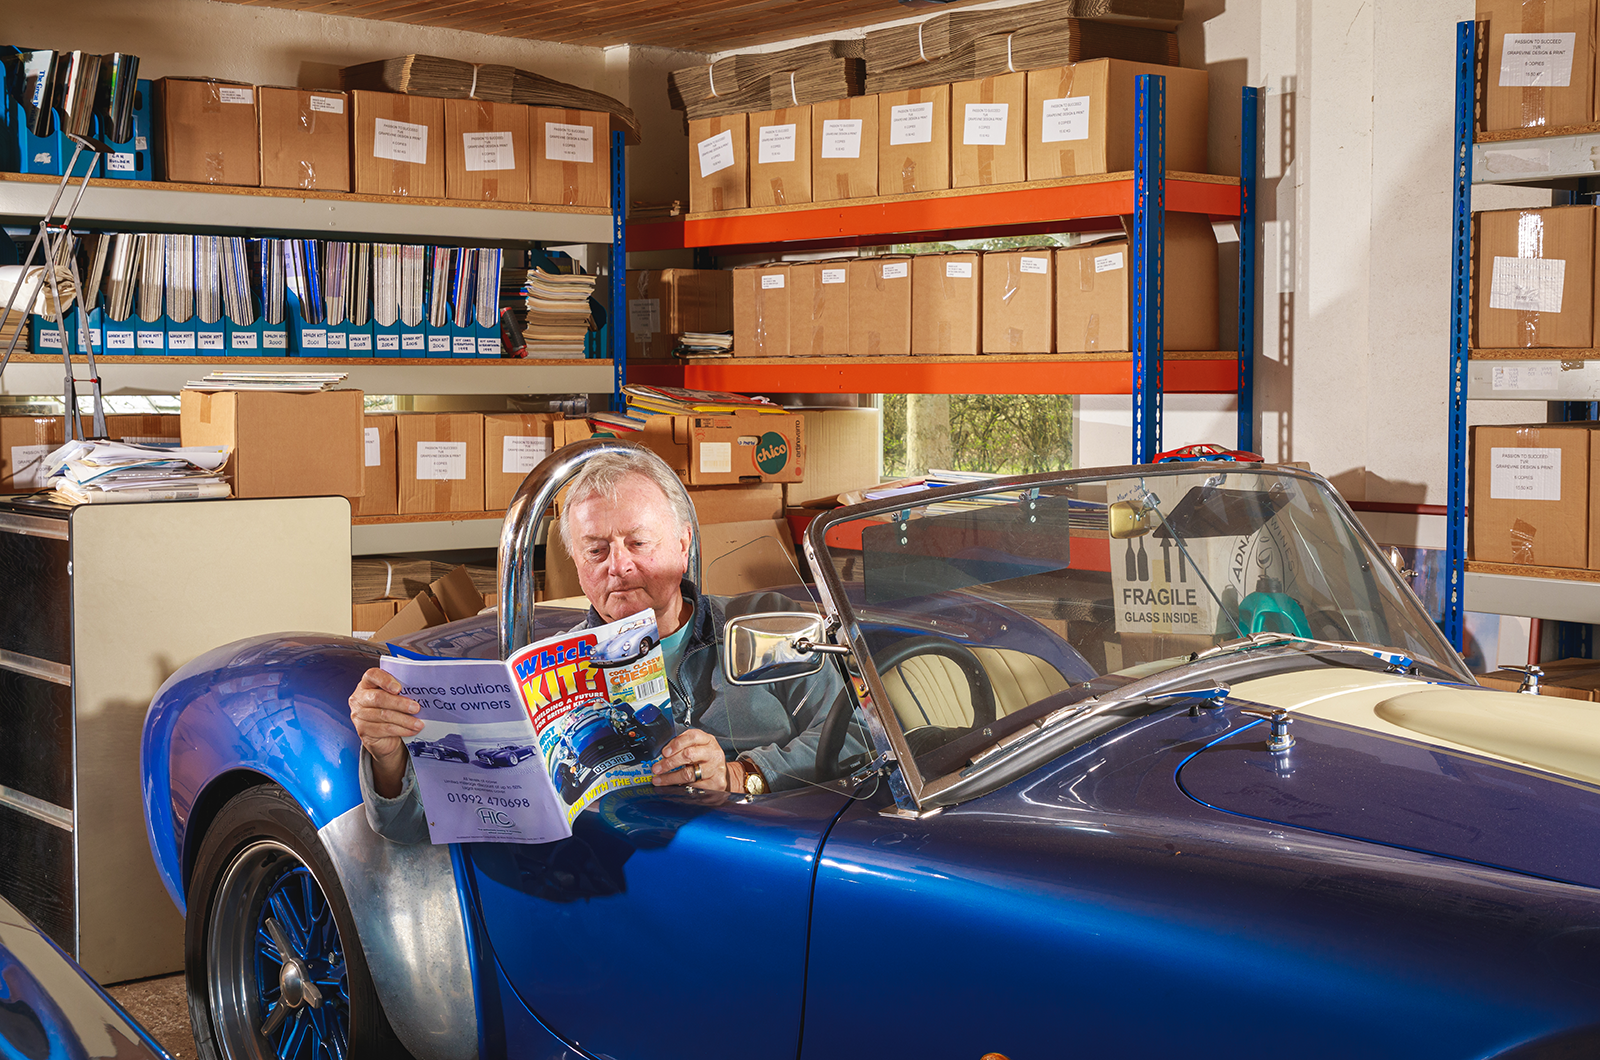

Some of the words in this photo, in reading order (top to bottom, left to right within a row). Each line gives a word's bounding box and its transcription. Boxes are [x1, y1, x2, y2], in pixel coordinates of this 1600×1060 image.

[757, 444, 787, 463] chico
[1232, 535, 1249, 584] ADNA
[1123, 588, 1197, 606] FRAGILE
[1125, 612, 1160, 623] GLASS
[1163, 612, 1198, 624] INSIDE
[515, 640, 593, 681] Which
[633, 656, 660, 670] CLASSY
[610, 664, 662, 685] CHESIL
[397, 684, 446, 696] urance
[450, 683, 511, 696] solutions
[522, 661, 599, 716] KIT?
[433, 698, 456, 711] Car
[460, 698, 511, 712] owners
[534, 701, 564, 724] BUILDING
[575, 692, 604, 700] FUTURE
[547, 705, 571, 720] BRITISH
[606, 769, 641, 778] 0-60mph
[585, 782, 609, 800] WITH
[610, 778, 630, 787] THE
[633, 775, 657, 784] GRE
[447, 793, 483, 804] 01992
[488, 797, 530, 808] 470698
[481, 810, 510, 825] HIC
